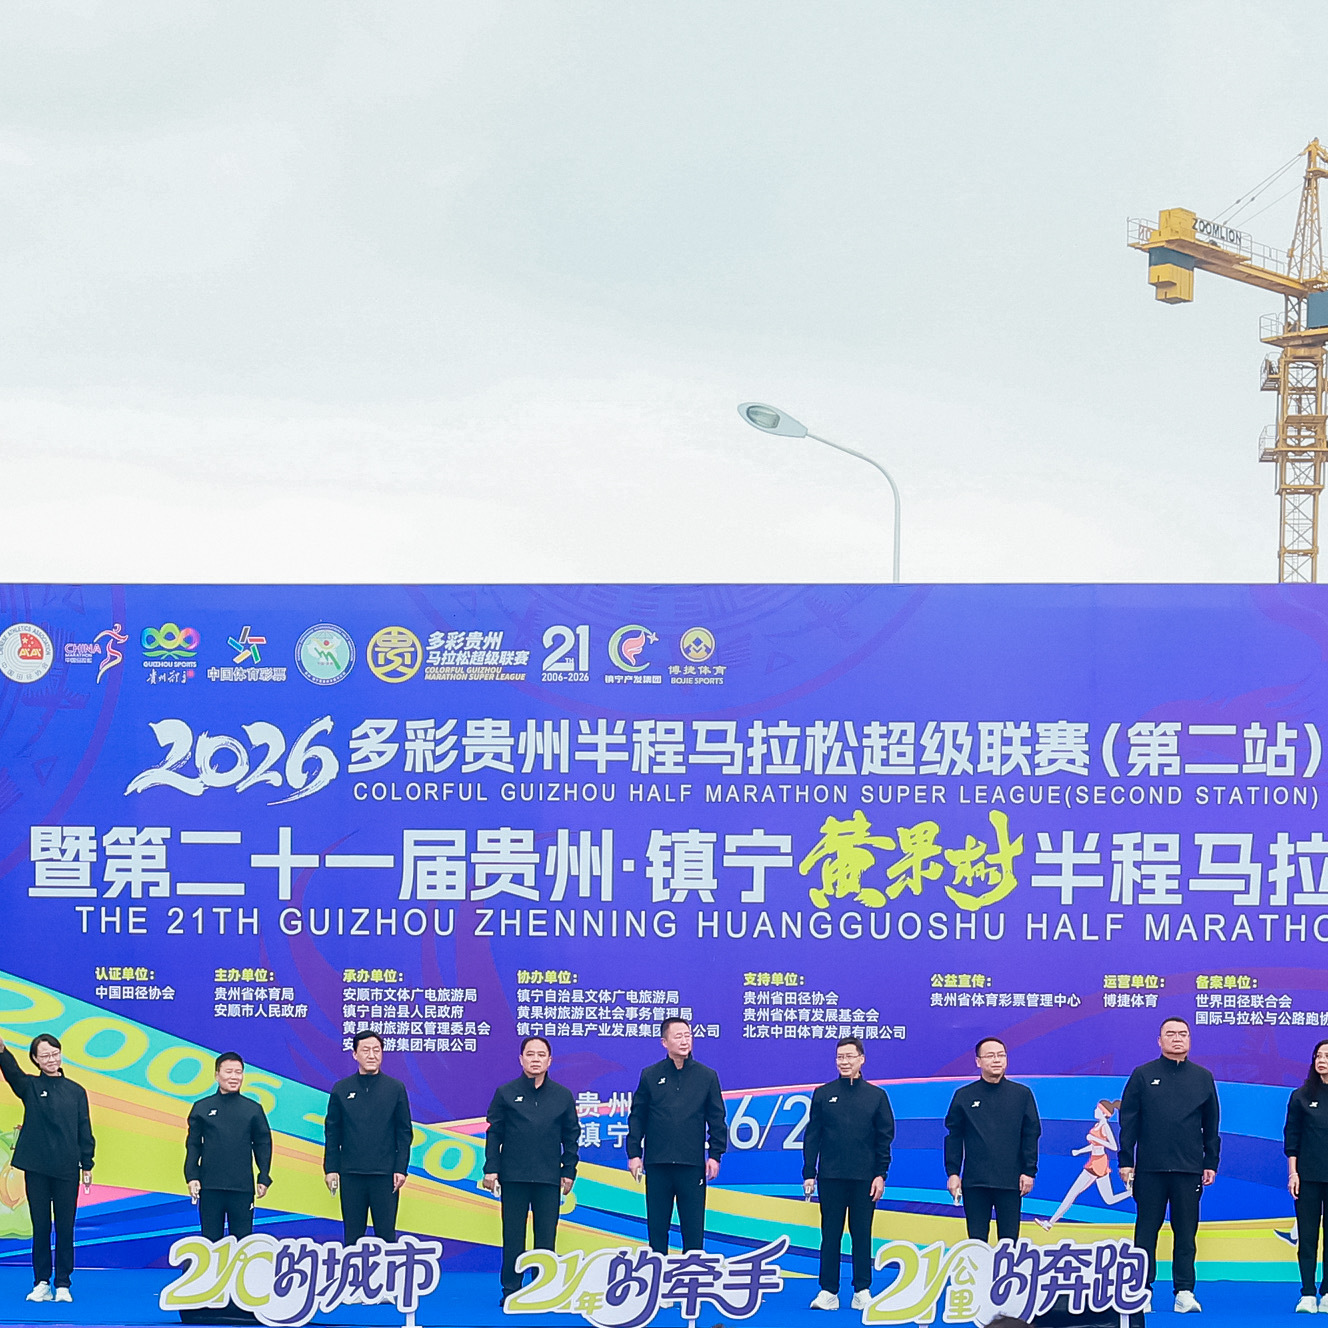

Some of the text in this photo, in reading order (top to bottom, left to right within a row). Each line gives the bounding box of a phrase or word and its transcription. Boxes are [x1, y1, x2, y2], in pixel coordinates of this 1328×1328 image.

[1192, 217, 1242, 245] ZOOMLION
[64, 643, 102, 654] CHINA
[426, 631, 504, 650] 多彩贵州
[542, 625, 589, 672] 21
[426, 650, 530, 666] 马拉松超级联赛
[541, 673, 589, 682] 2006-2026
[124, 714, 339, 805] 2026
[354, 782, 489, 804] COLORFUL
[501, 782, 617, 804] GUIZHOU
[629, 783, 695, 804] HALF
[705, 783, 849, 806] MARATHON
[861, 784, 950, 807] SUPER
[1194, 784, 1321, 809] STATION)
[75, 906, 149, 935] THE
[167, 906, 260, 936] 21TH
[278, 906, 455, 937] GUIZHOU
[475, 907, 678, 939] ZHENNING
[698, 910, 1007, 942] HUANGGUOSHU
[1027, 911, 1124, 942] HALF
[95, 966, 156, 982] 认证单位:
[213, 968, 275, 983] 主办单位:
[342, 968, 404, 984] 承办单位:
[516, 970, 578, 986] 协办单位:
[743, 972, 805, 987] 支持单位:
[930, 973, 992, 988] 公益宣传:
[1103, 974, 1165, 989] 运营单位:
[1195, 975, 1258, 990] 备案单位:
[95, 986, 176, 1001] 中国田径协会
[213, 986, 294, 1002] 贵州省体育局
[342, 987, 477, 1003] 安顺市文体广电旅游局
[516, 988, 680, 1005] 镇宁自治县文体广电旅游局
[743, 990, 839, 1006] 贵州省田径协会
[930, 992, 1082, 1008] 贵州省体育彩票管理中心
[1103, 993, 1159, 1008] 博捷体育
[1195, 994, 1292, 1010] 世界田径联合会
[213, 1003, 308, 1019] 安顺市人民政府
[342, 1003, 464, 1020] 镇宁自治县人民政府
[516, 1005, 693, 1022] 黄果树旅游区社会事务管理局
[743, 1007, 879, 1023] 贵州省体育发展基金会
[342, 1020, 491, 1036] 黄果树旅游区管理委员会
[516, 1022, 720, 1038] 镇宁自治县产业发展集团公司
[743, 1024, 906, 1040] 北京中田体育发展有限公司
[342, 1036, 477, 1052] 安游集团有限公司
[576, 1092, 632, 1118] 贵州
